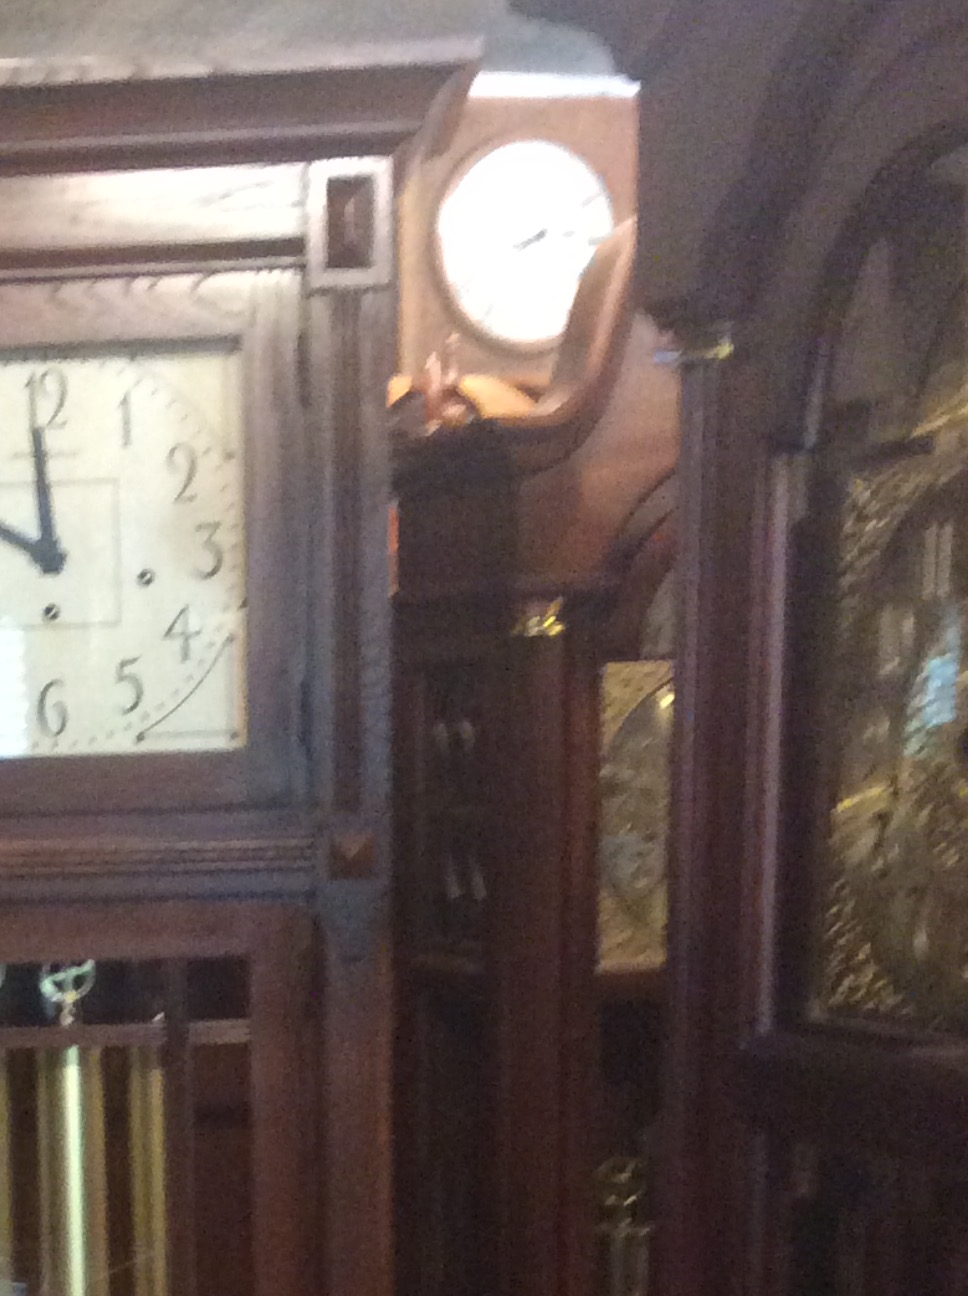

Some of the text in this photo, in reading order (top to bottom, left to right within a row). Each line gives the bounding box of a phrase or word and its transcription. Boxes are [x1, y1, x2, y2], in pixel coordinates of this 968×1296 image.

[24, 367, 68, 430] 12
[118, 390, 132, 448] 1
[165, 442, 199, 504] 2
[193, 521, 224, 580] 3
[162, 604, 201, 662] 4
[37, 678, 69, 738] 6
[115, 655, 144, 715] 5
